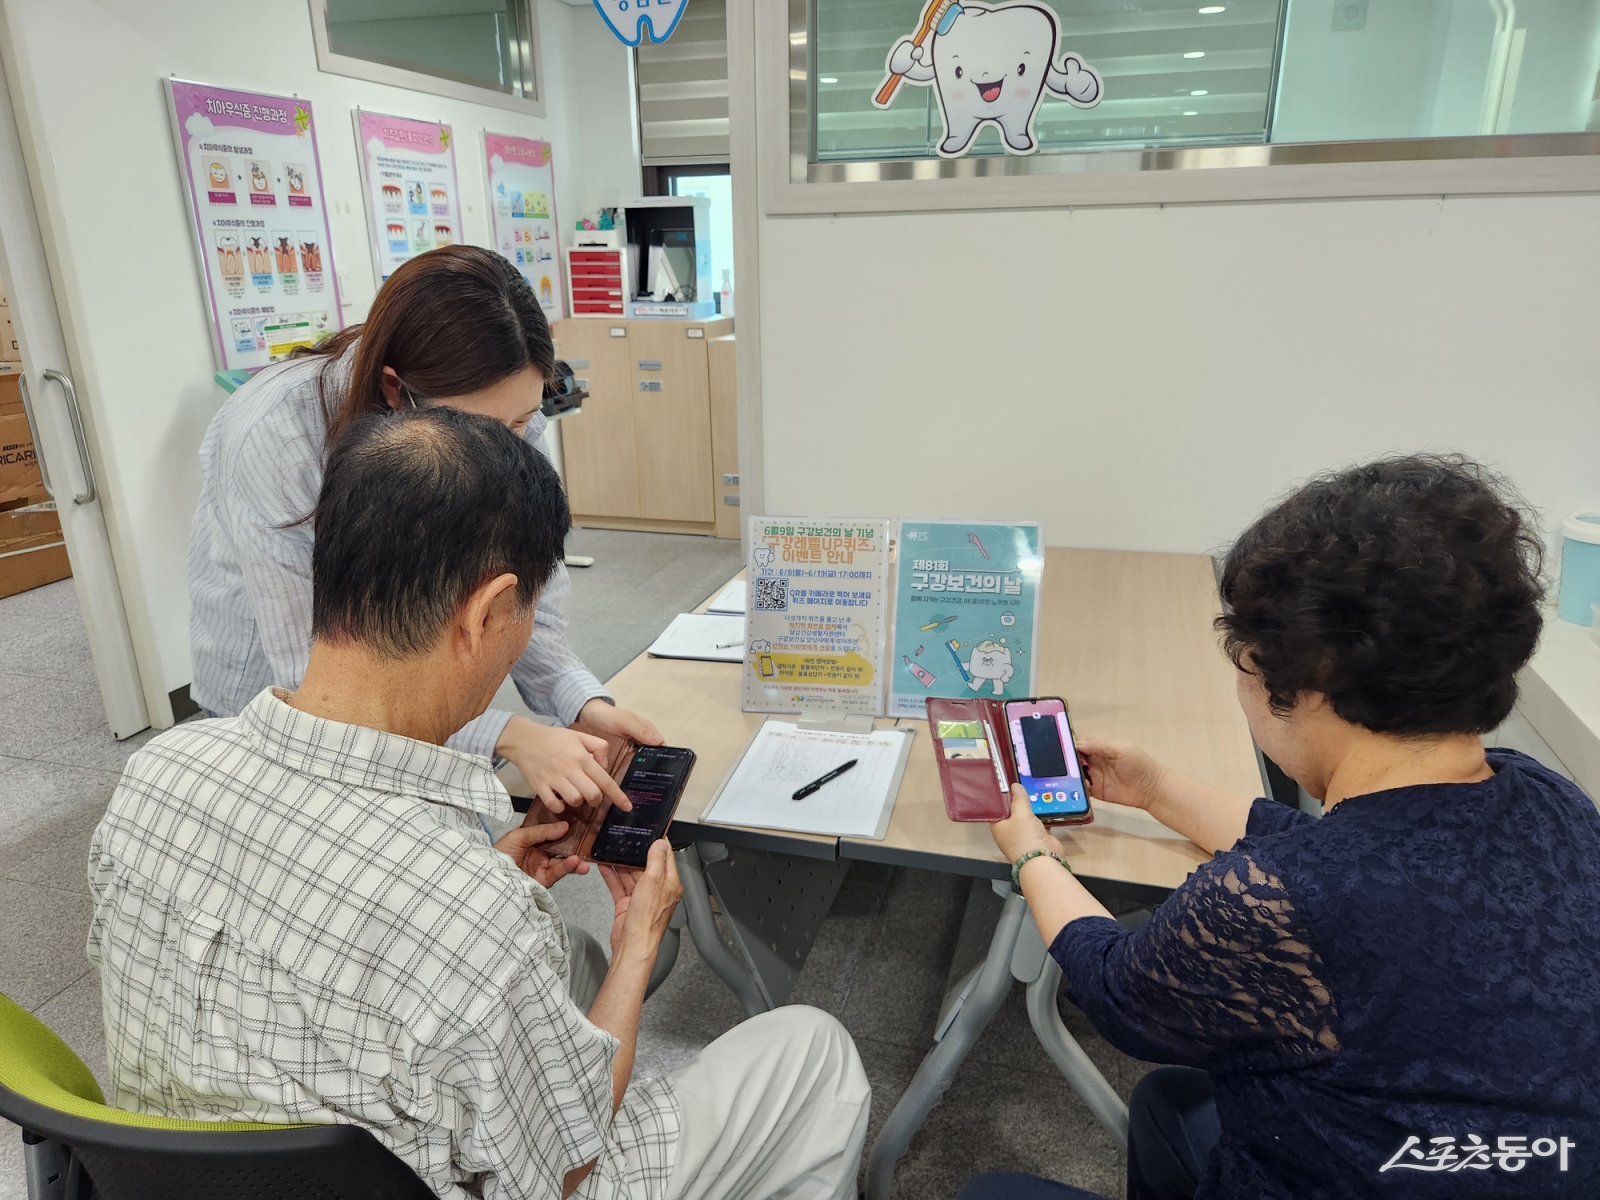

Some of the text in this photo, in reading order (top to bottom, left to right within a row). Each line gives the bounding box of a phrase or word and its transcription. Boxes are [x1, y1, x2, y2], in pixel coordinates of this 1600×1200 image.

[206, 98, 289, 125] 치아우식증 진행과정
[764, 526, 874, 538] 6월9일 구강보건의 날 기념
[782, 550, 853, 564] 이벤트 안내
[912, 560, 949, 572] 제81회
[839, 570, 872, 579] 17:00까지
[911, 573, 1022, 596] 구강보건의 날
[809, 590, 835, 598] 카메라로
[852, 591, 871, 599] 보세요
[835, 598, 868, 607] 이동합니다
